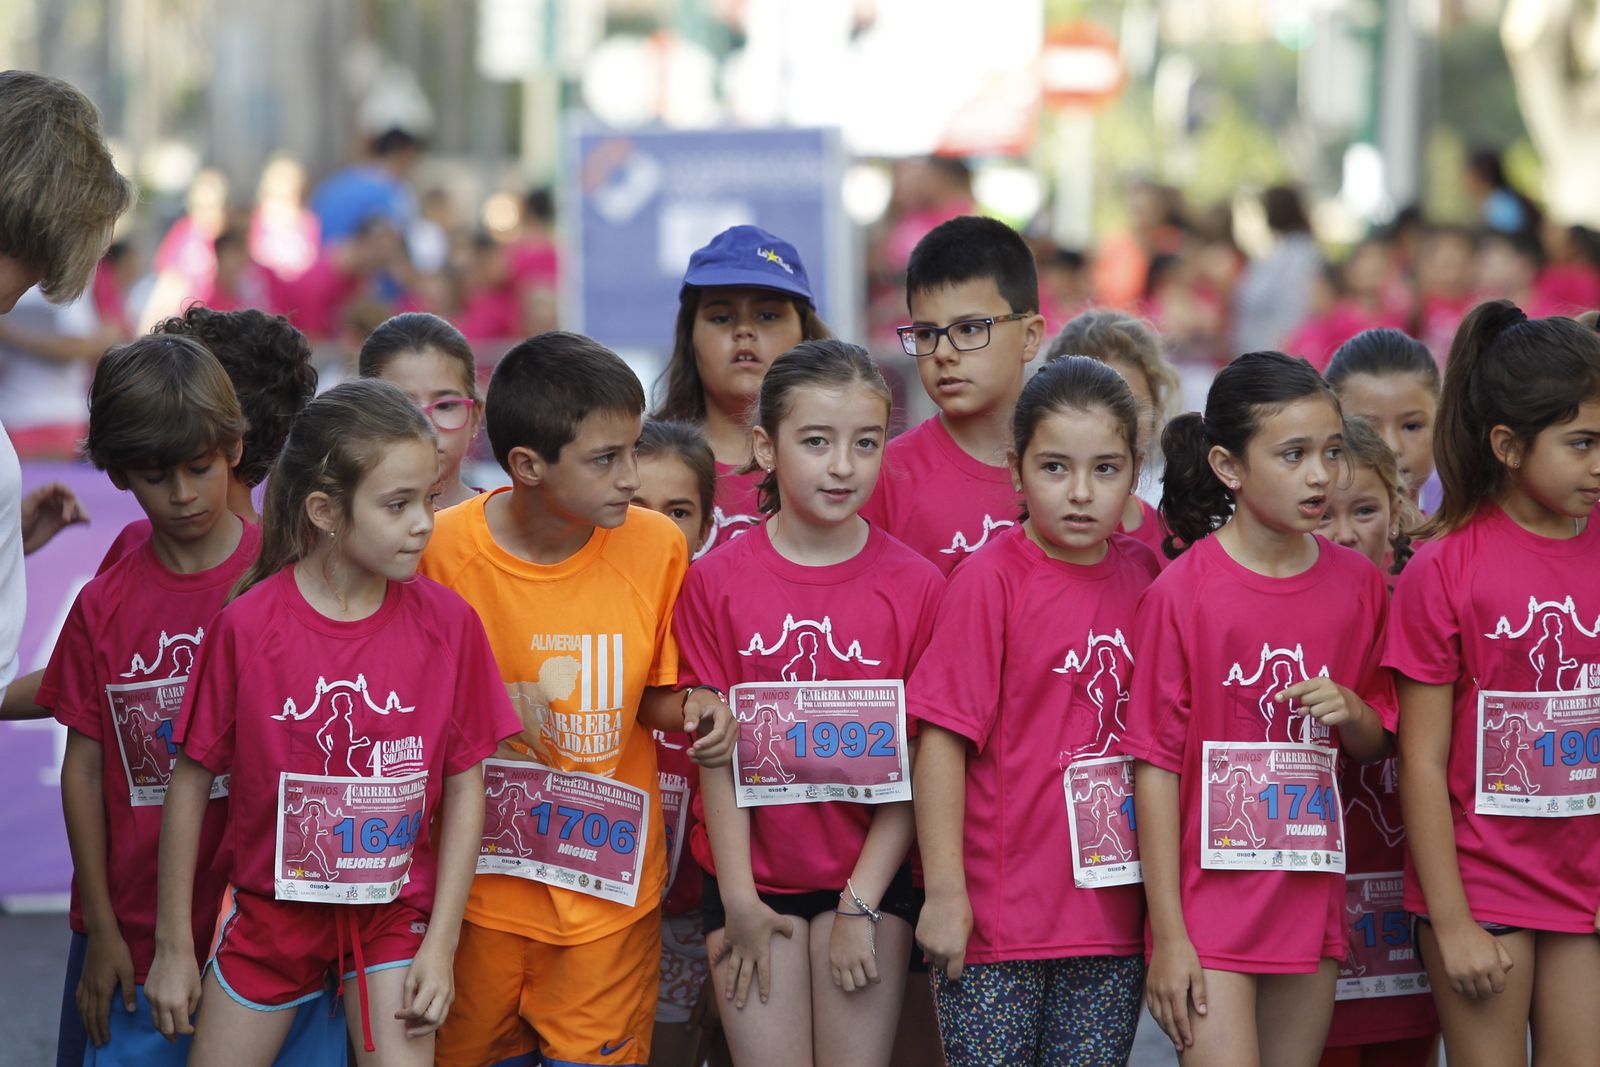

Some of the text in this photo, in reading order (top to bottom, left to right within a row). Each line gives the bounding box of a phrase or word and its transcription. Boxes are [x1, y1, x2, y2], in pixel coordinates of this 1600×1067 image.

[530, 634, 582, 650] ALMERIA
[1574, 663, 1589, 691] 4
[762, 690, 790, 700] NIÑOS
[793, 688, 804, 710] 4
[803, 689, 847, 701] CARRERA
[848, 689, 896, 701] SOLIDARIA
[1511, 699, 1540, 710] NIÑOS
[1543, 698, 1553, 720] 4
[1552, 698, 1592, 710] CARRERA
[785, 721, 897, 758] 1992
[366, 735, 424, 777] 4 CARRERA
[1235, 751, 1263, 762] NIÑOS
[1266, 750, 1276, 772] 4
[1275, 752, 1311, 764] CARRERA
[658, 772, 688, 789] RERA
[762, 776, 778, 784] Salle
[1569, 768, 1598, 781] SOLEA
[310, 784, 338, 795] NIÑOS
[342, 783, 354, 806] 4
[352, 785, 397, 797] CARRERA
[542, 772, 553, 791] 4
[596, 784, 641, 806] SOLIDARIA
[1504, 784, 1521, 792] Salle
[1120, 795, 1137, 831] 1
[1259, 783, 1336, 822] 1741
[530, 801, 637, 855] 1706
[1285, 824, 1327, 836] YOLANDA
[336, 857, 386, 869] MEJORES
[557, 843, 598, 862] MIGUEL
[1084, 856, 1093, 865] La
[305, 870, 321, 878] Salle
